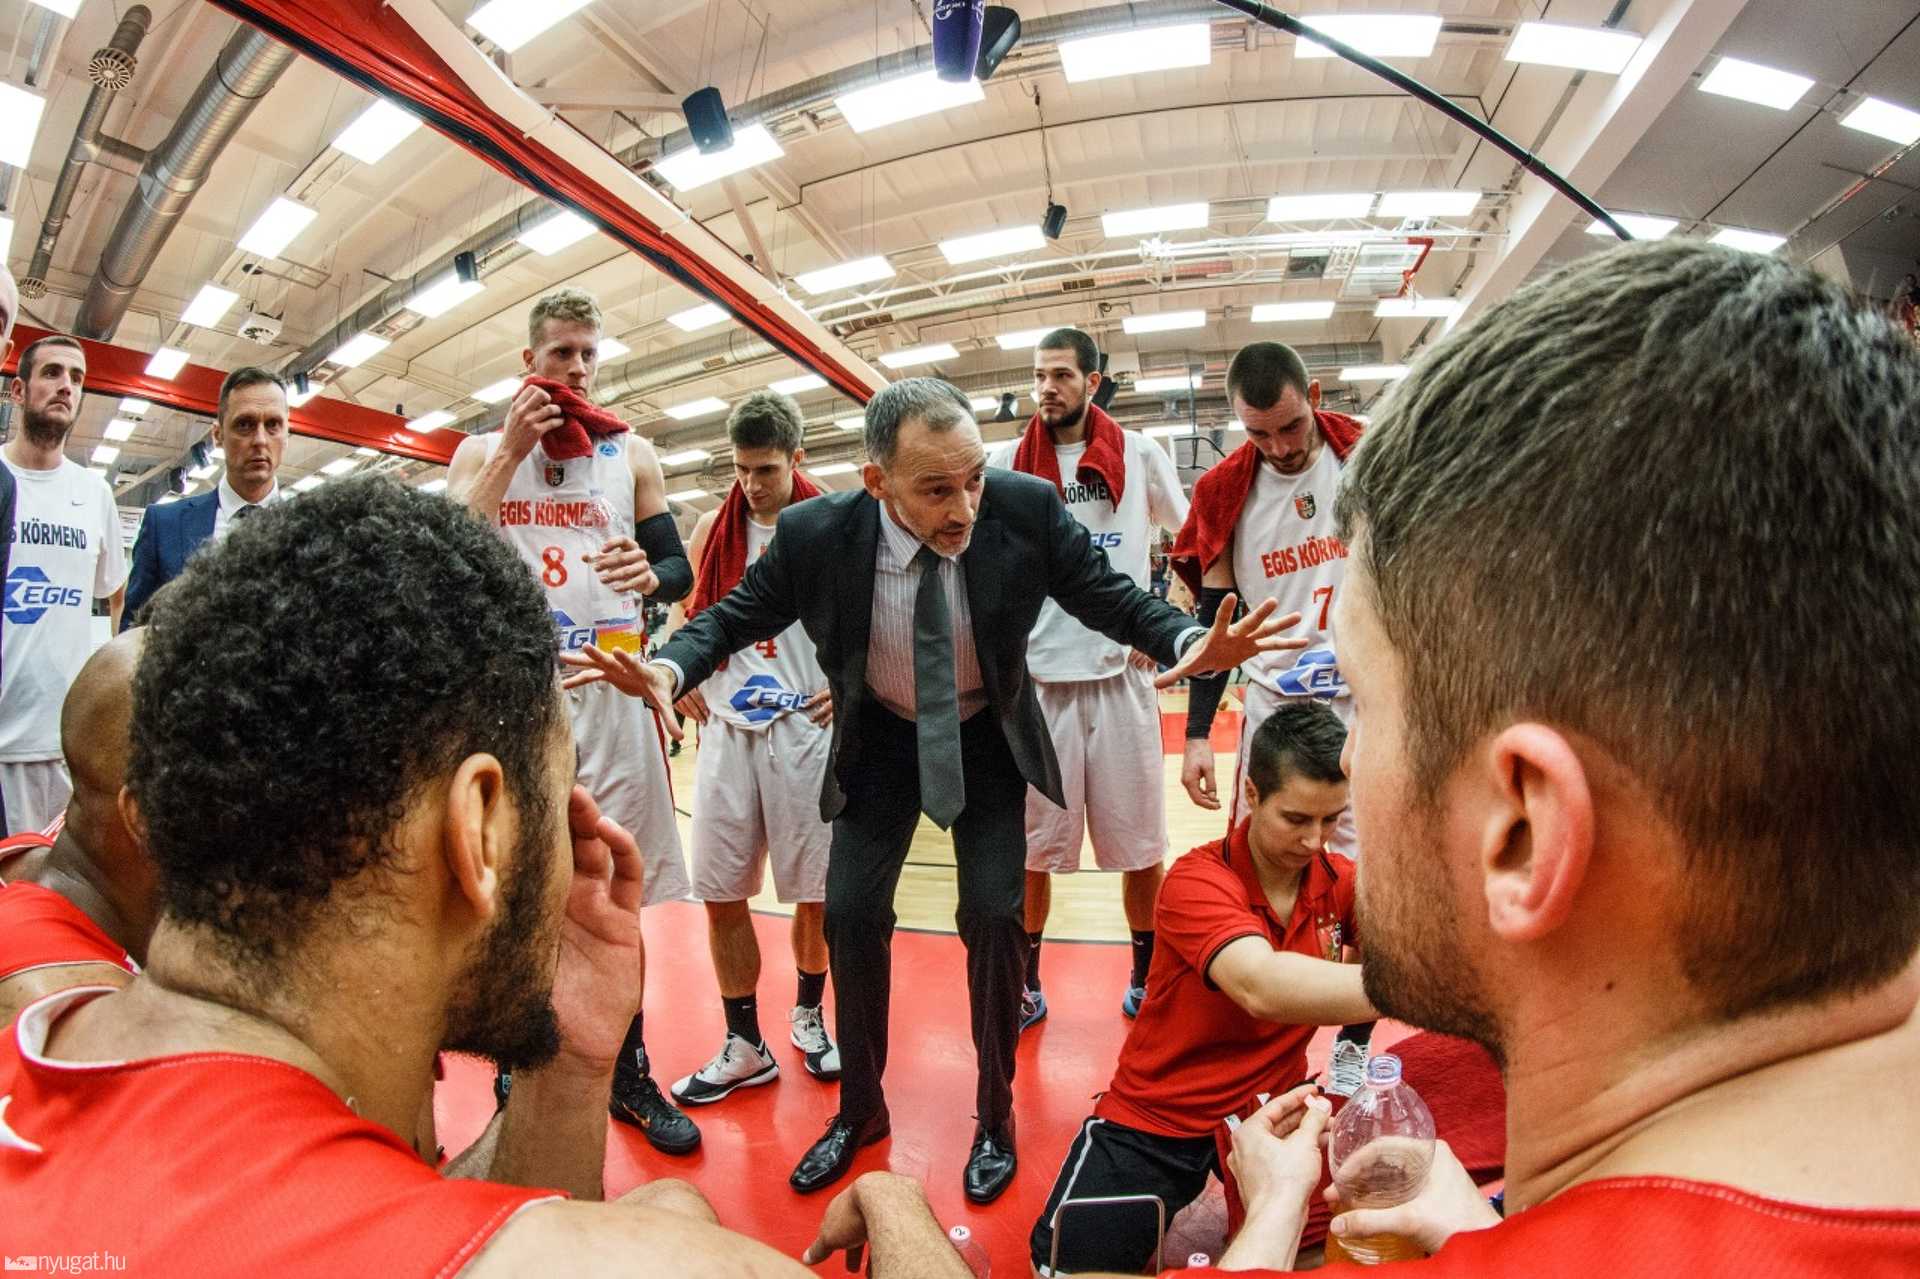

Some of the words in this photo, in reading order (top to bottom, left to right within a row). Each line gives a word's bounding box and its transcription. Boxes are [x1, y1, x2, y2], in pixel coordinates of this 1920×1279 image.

[20, 517, 88, 550] KÖRMEND
[542, 546, 568, 588] 8
[1261, 546, 1298, 578] EGIS
[22, 585, 84, 607] EGIS
[1312, 585, 1334, 631] 7
